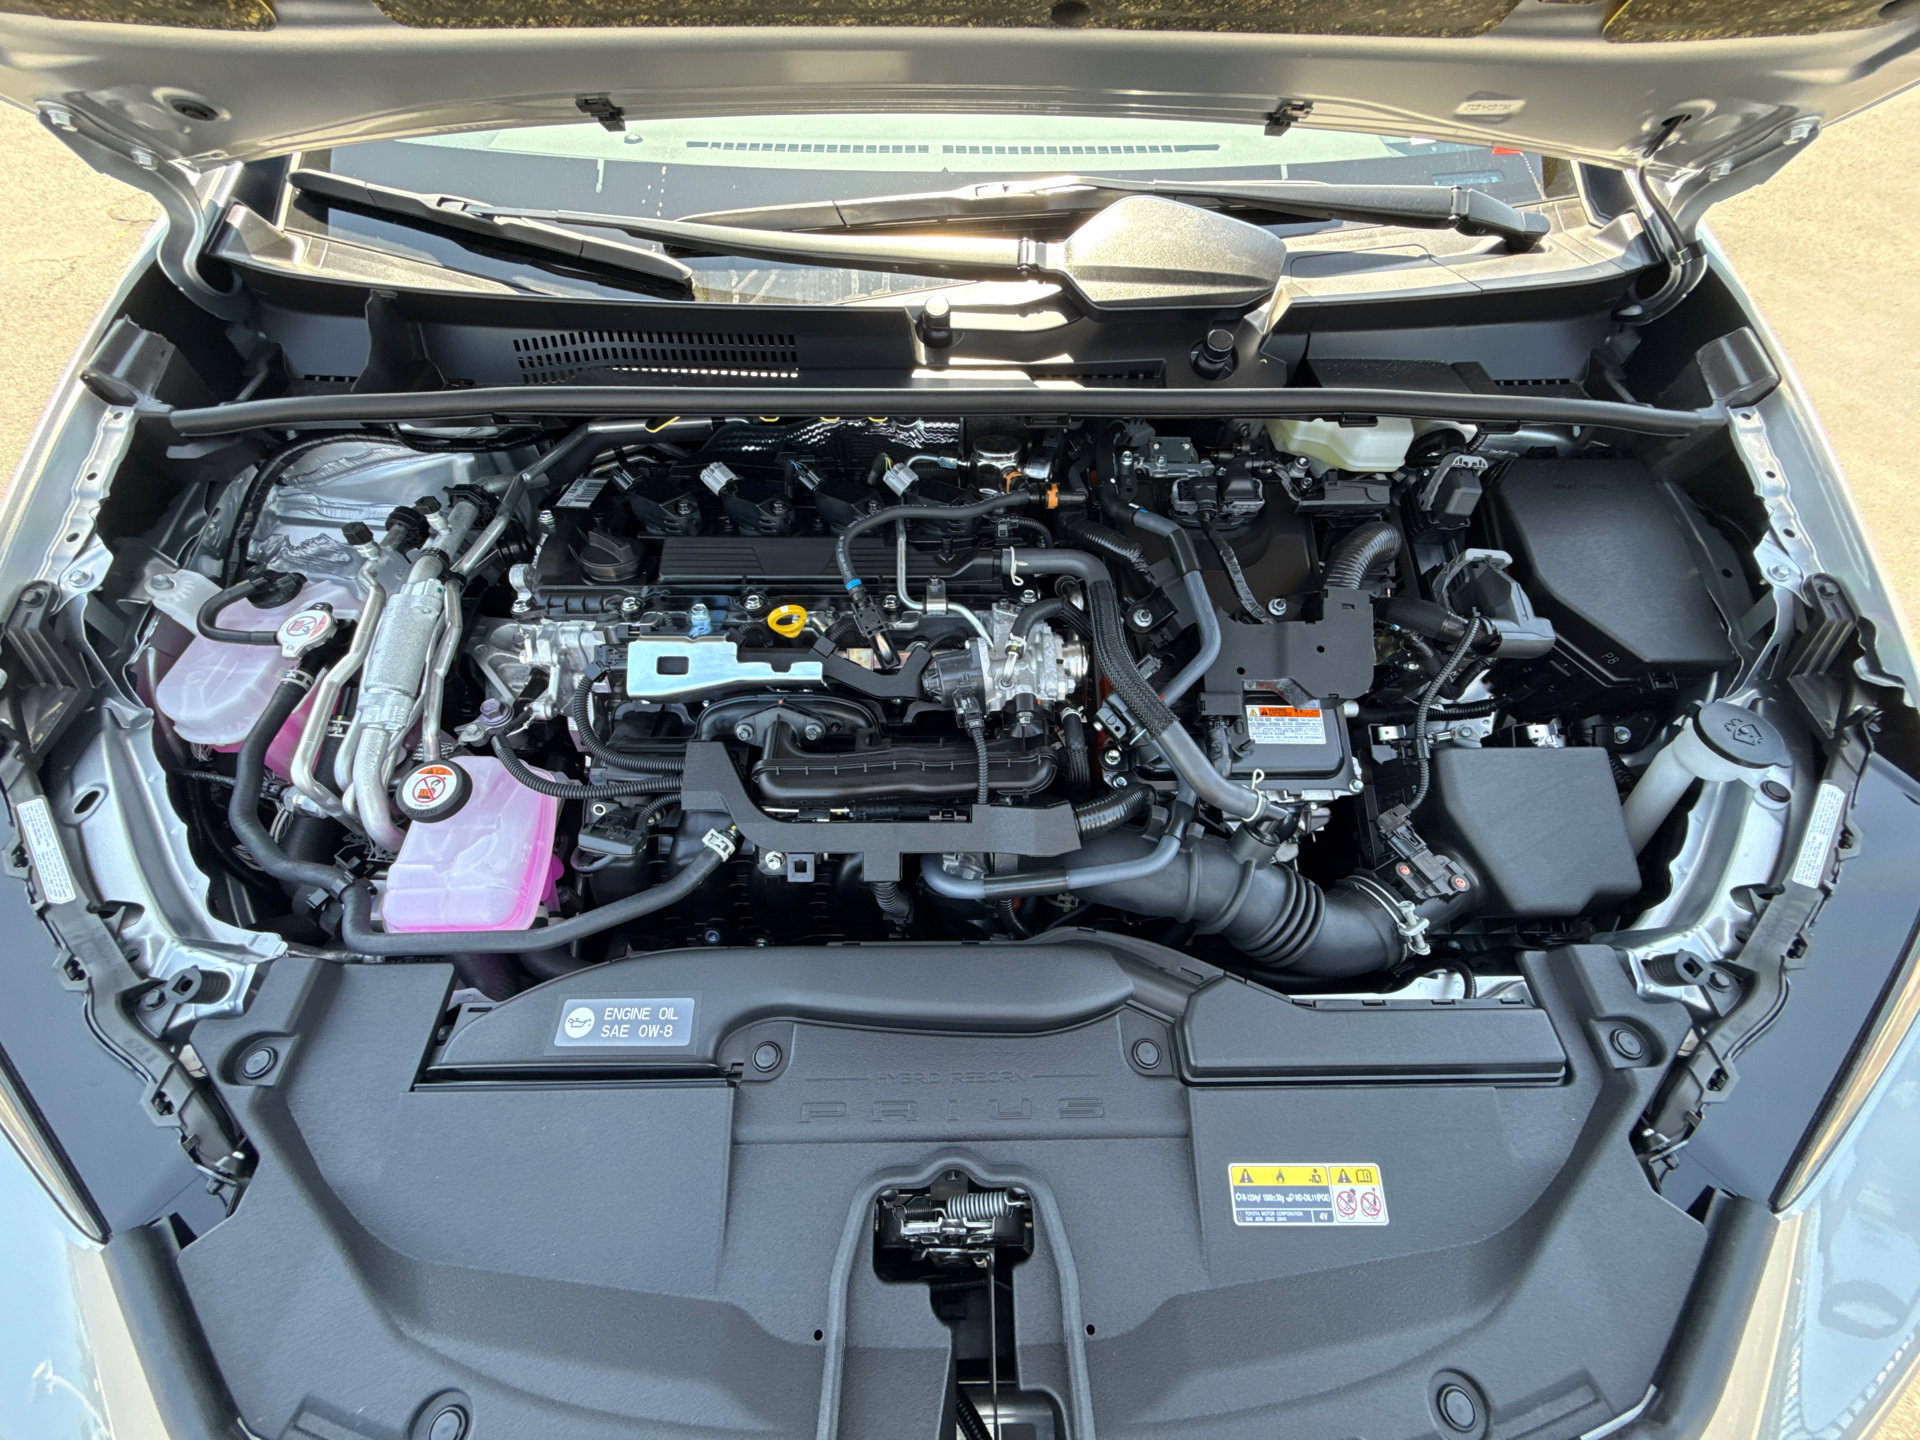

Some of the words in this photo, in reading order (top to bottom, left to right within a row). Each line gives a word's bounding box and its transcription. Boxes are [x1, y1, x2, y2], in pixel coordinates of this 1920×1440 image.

[604, 1007, 651, 1020] ENGINE
[659, 1007, 679, 1020] OIL
[600, 1025, 630, 1038] SAE
[800, 1098, 1104, 1122] PRIUS
